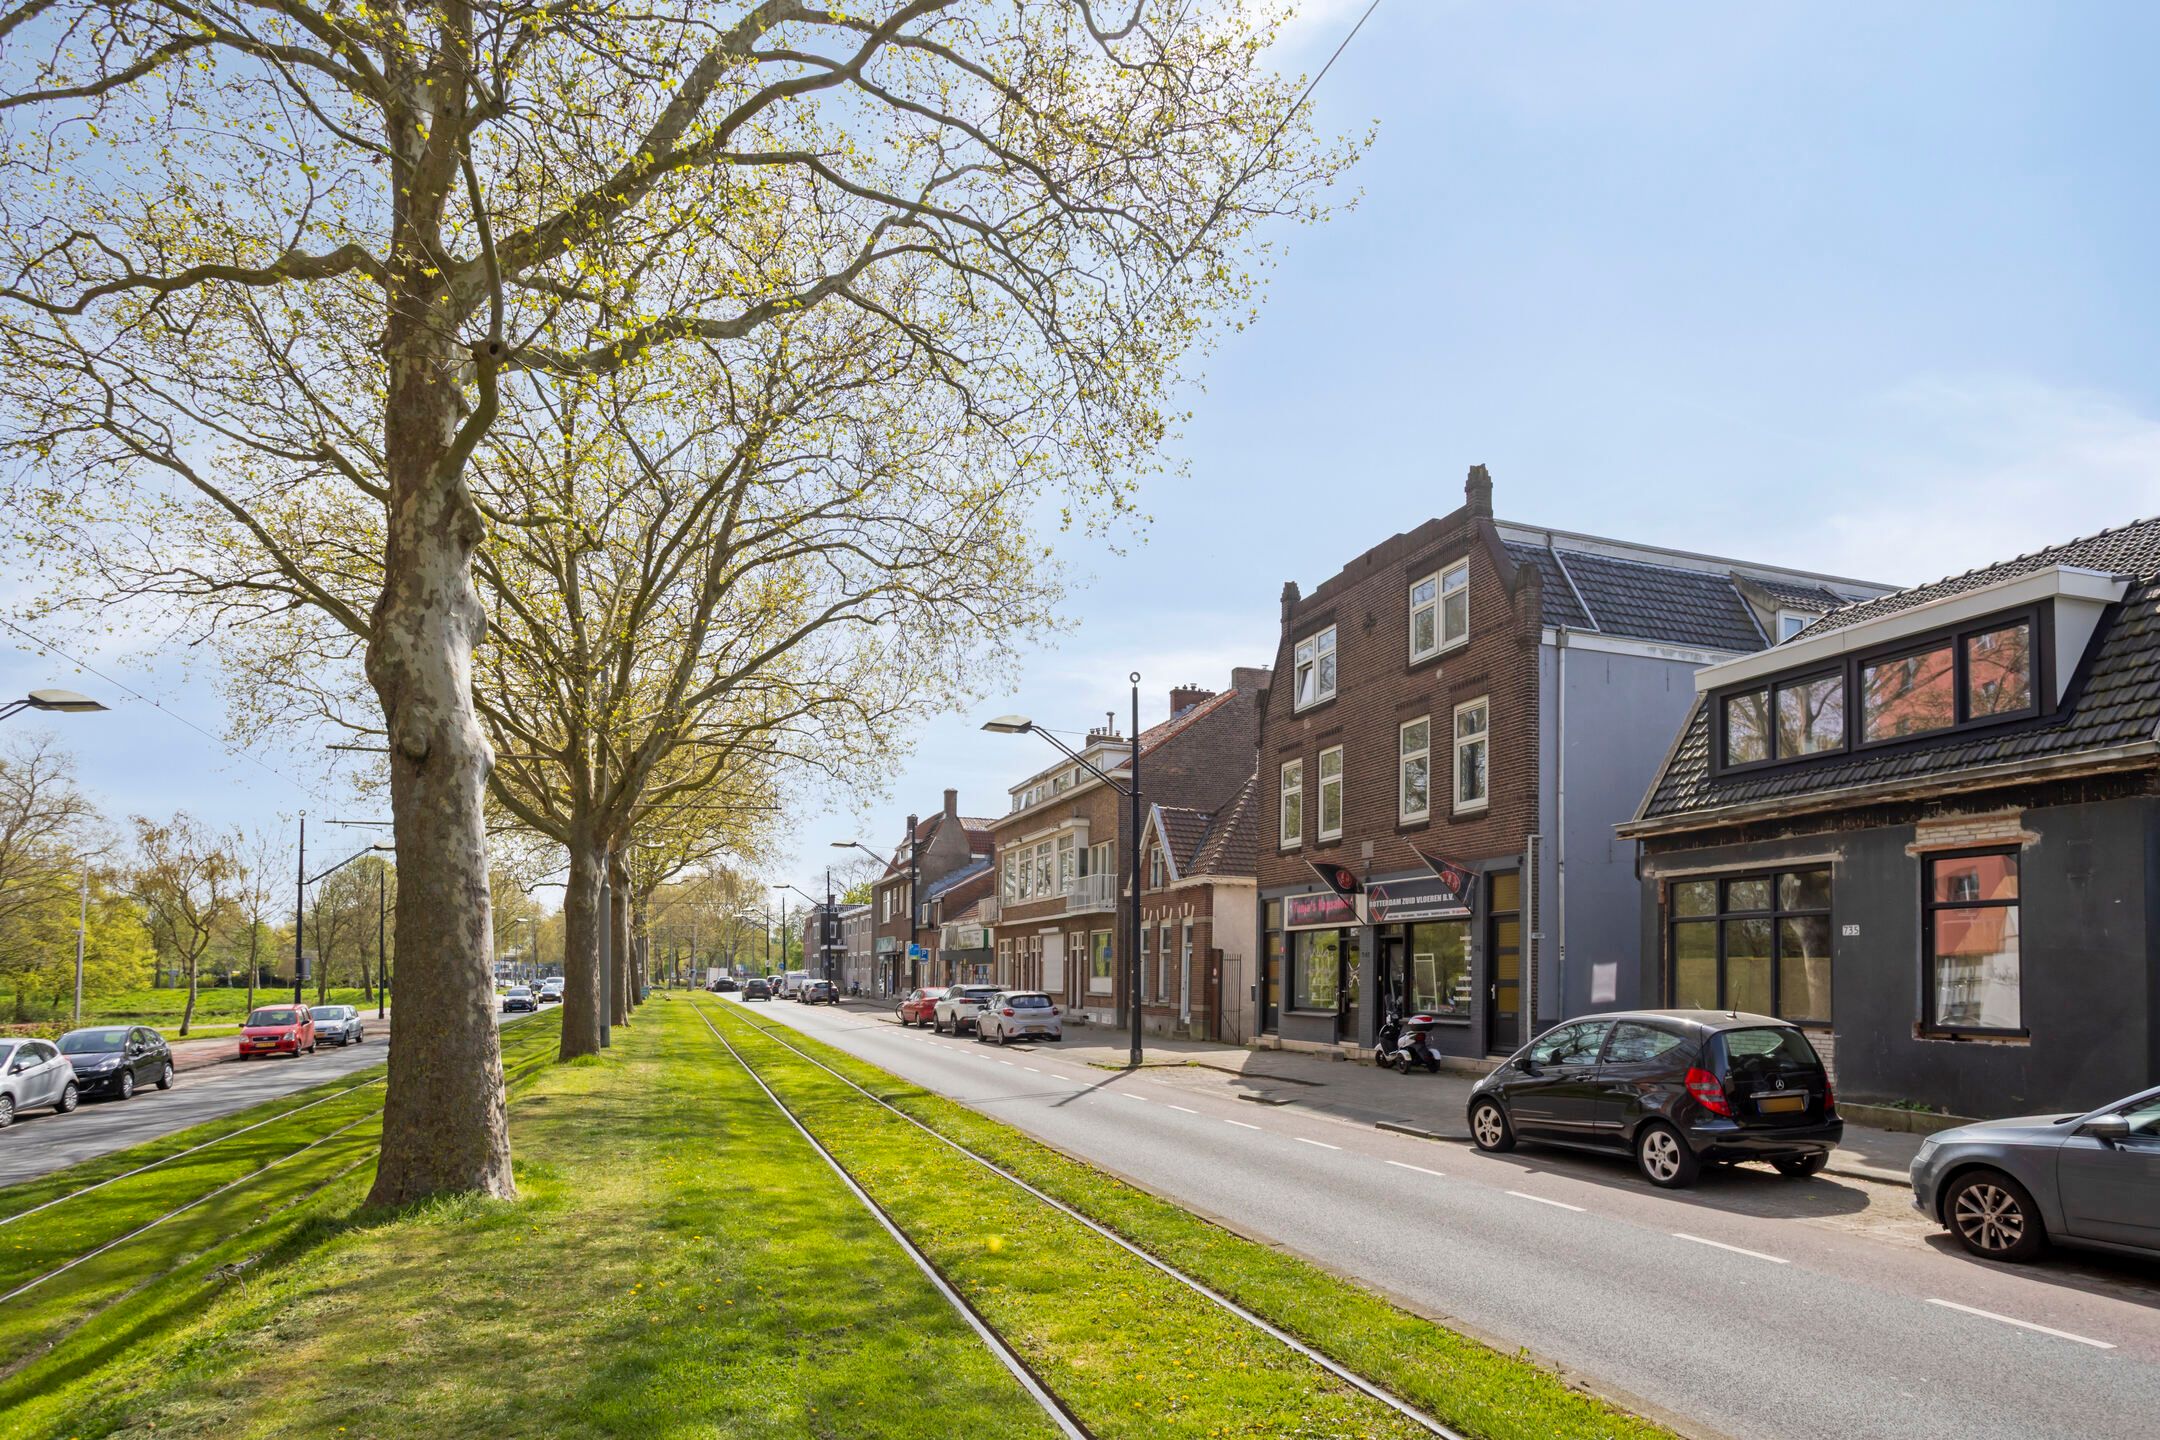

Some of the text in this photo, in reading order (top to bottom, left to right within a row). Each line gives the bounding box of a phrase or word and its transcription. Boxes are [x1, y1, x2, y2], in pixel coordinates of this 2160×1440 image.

[1369, 897, 1401, 908] ROTTERDAM
[1402, 896, 1415, 905] ZUID
[1416, 894, 1441, 904] VLOEREN
[1844, 926, 1859, 935] 735
